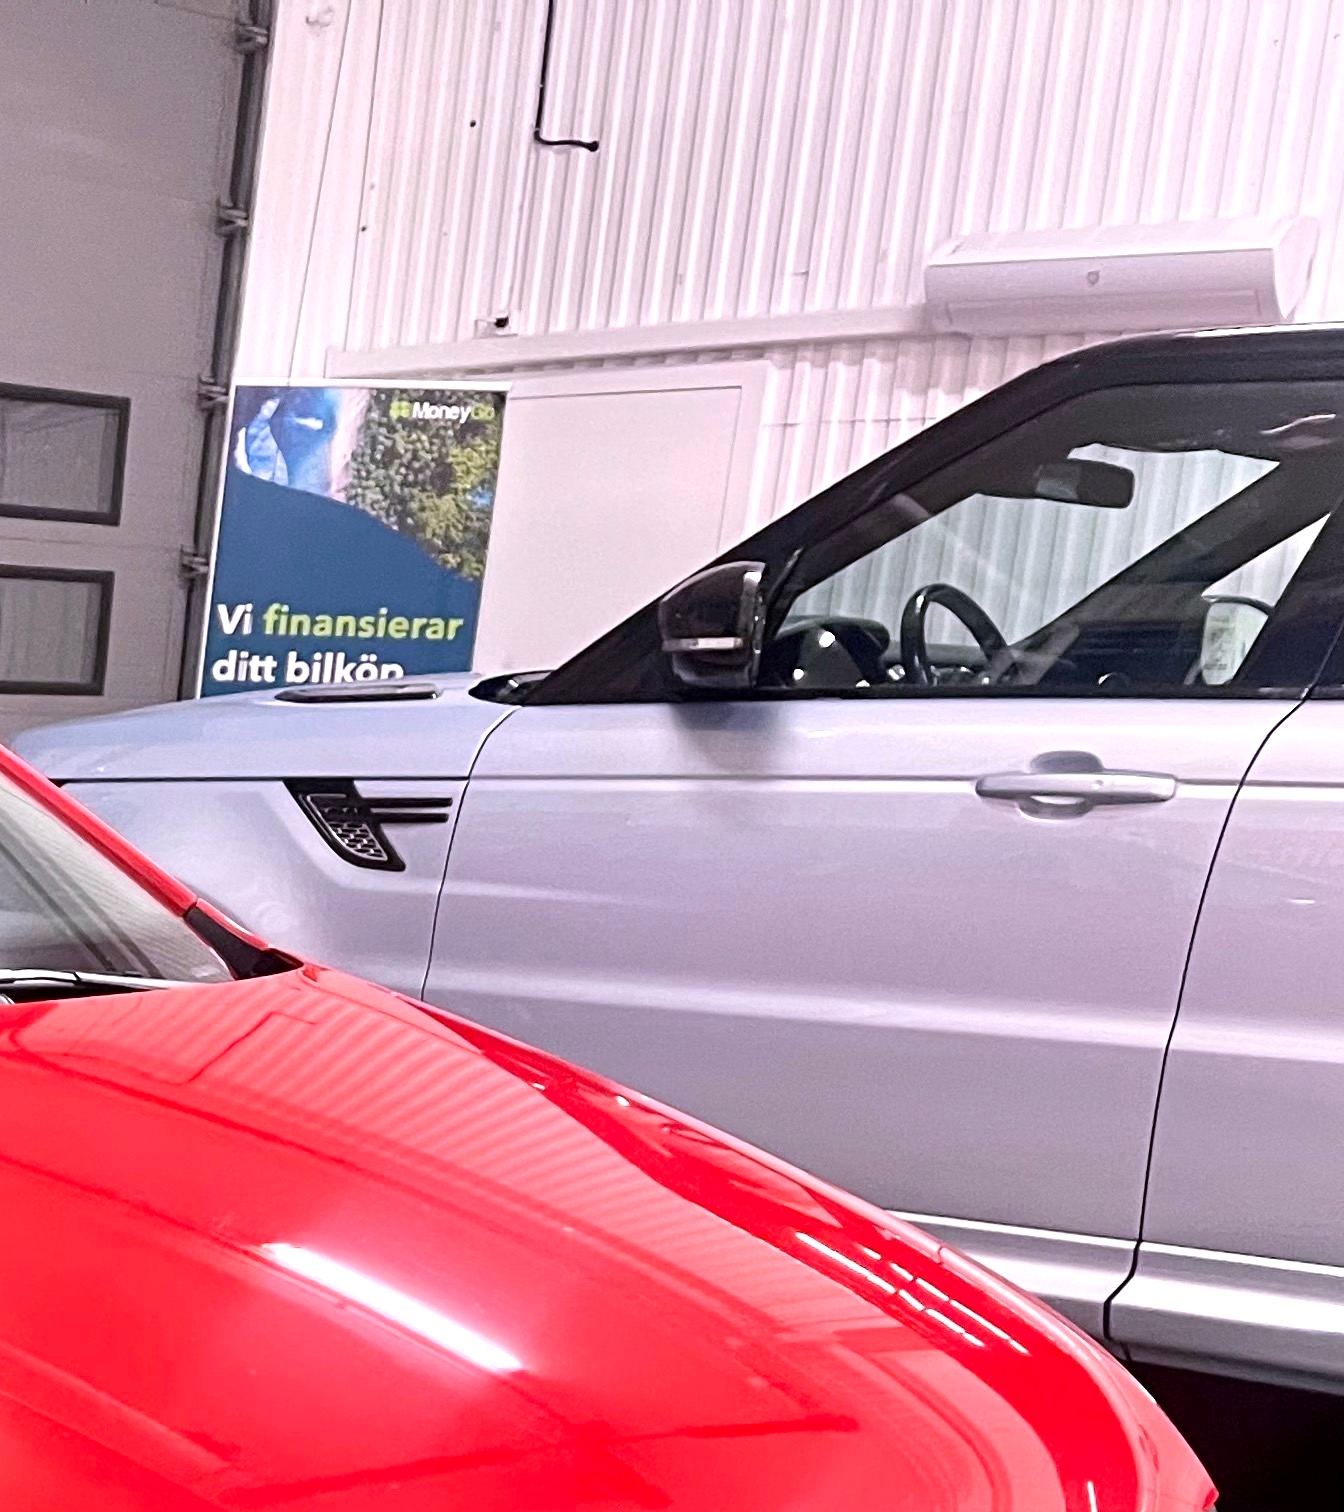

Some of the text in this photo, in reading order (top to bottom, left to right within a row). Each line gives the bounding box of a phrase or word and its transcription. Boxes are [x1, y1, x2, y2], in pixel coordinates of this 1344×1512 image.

[411, 401, 496, 424] MoneyGo
[217, 603, 464, 640] Vi finansierar
[212, 649, 278, 683] ditt
